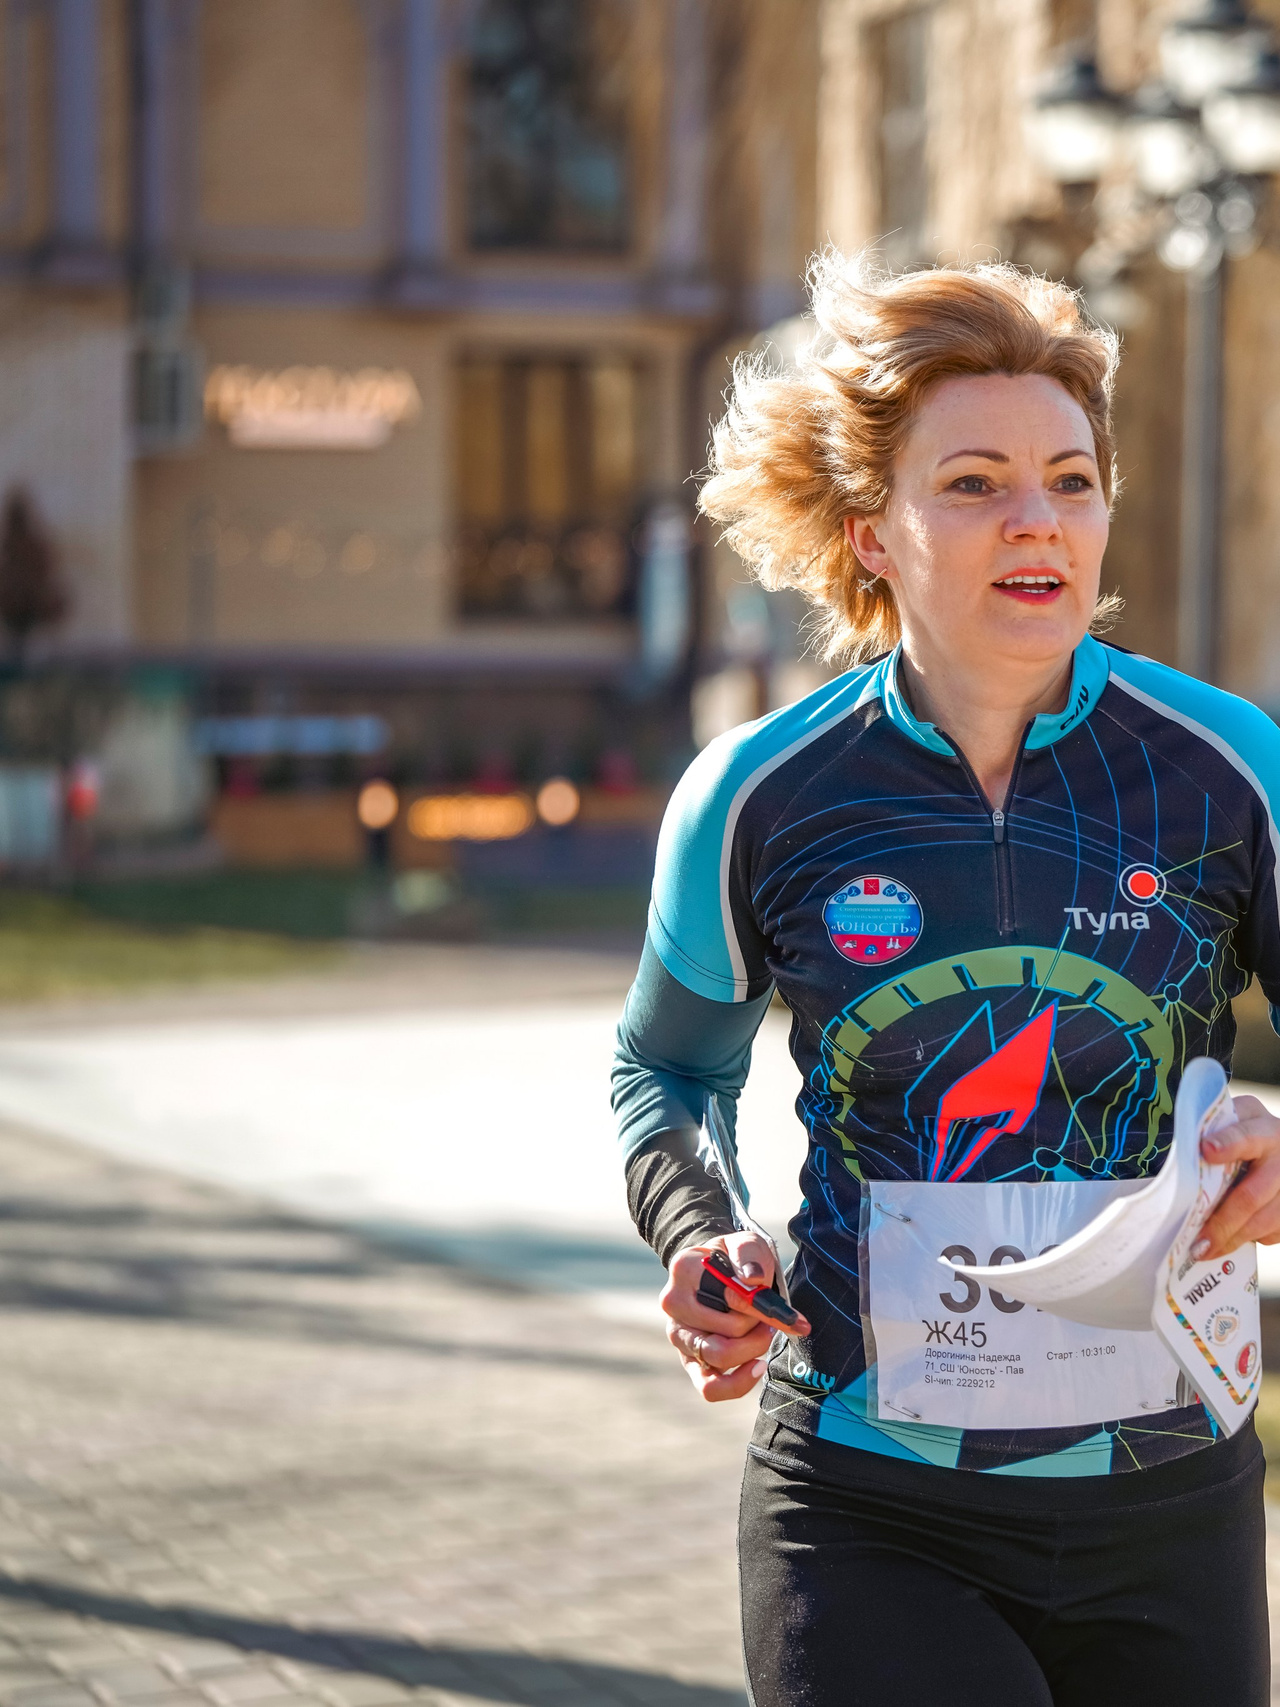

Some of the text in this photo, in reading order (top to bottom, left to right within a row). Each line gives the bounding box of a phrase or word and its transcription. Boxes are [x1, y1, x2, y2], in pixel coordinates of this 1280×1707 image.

[1063, 907, 1151, 936] Тула
[939, 1244, 1061, 1314] 30
[921, 1319, 988, 1348] Ж45
[924, 1347, 1021, 1363] Дорогинина Надежда
[1046, 1351, 1073, 1361] Старт
[1080, 1344, 1116, 1358] 10:31:00
[793, 1361, 836, 1391] OLLY
[1005, 1365, 1024, 1375] Пав
[956, 1377, 996, 1389] 2229212
